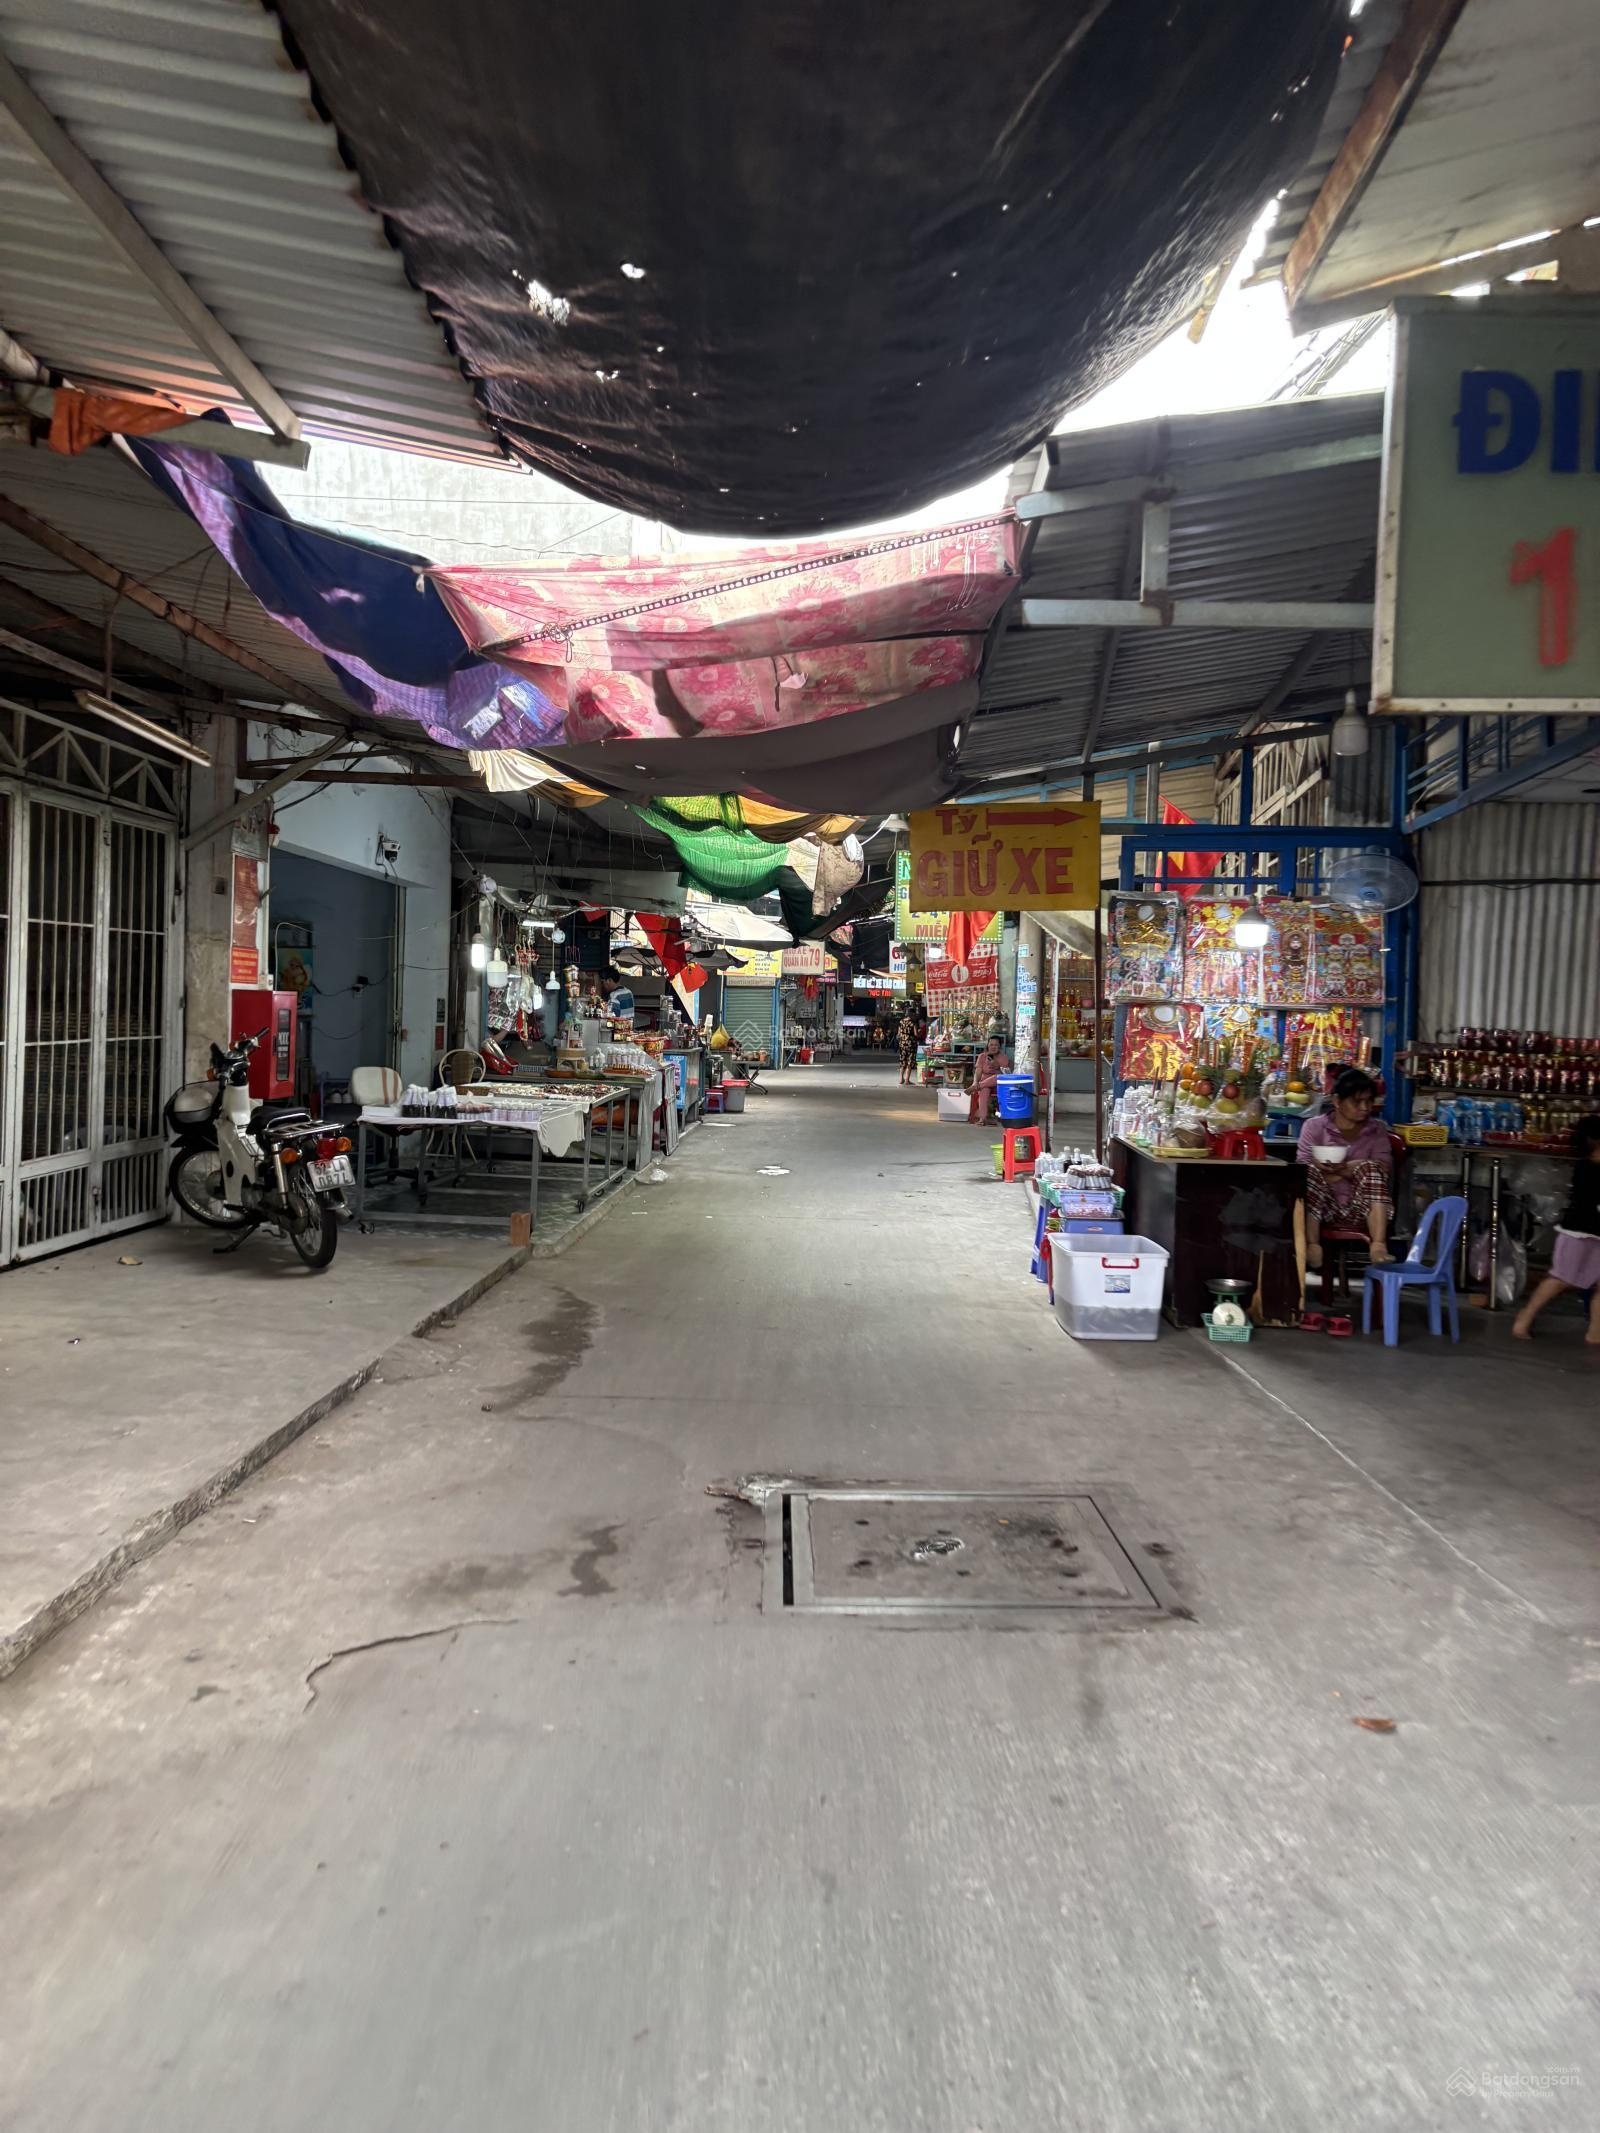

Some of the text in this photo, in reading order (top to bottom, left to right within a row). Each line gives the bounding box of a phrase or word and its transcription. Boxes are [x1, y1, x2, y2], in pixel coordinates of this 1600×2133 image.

[1452, 369, 1600, 475] ĐI
[1509, 525, 1579, 667] 1
[935, 807, 979, 836] Tý
[916, 831, 1074, 897] GIỮ XE
[810, 948, 820, 966] 79
